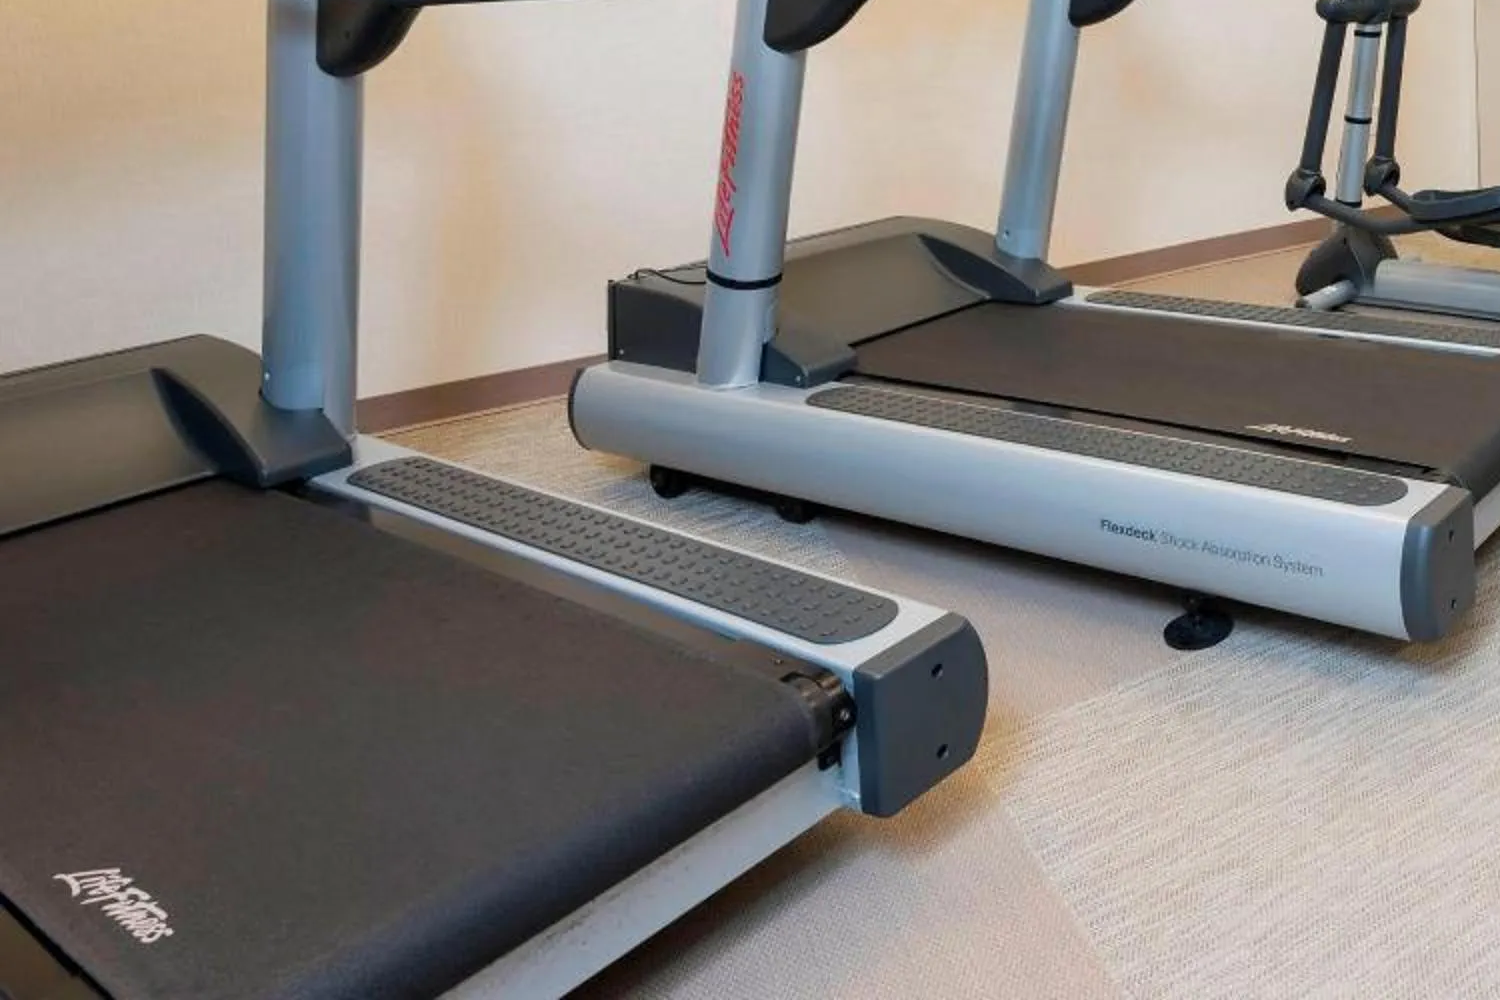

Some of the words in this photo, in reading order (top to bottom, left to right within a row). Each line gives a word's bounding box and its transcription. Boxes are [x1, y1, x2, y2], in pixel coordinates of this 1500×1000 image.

[1100, 518, 1155, 542] Flexdeck
[1160, 530, 1198, 550] Shock
[1272, 552, 1324, 578] System
